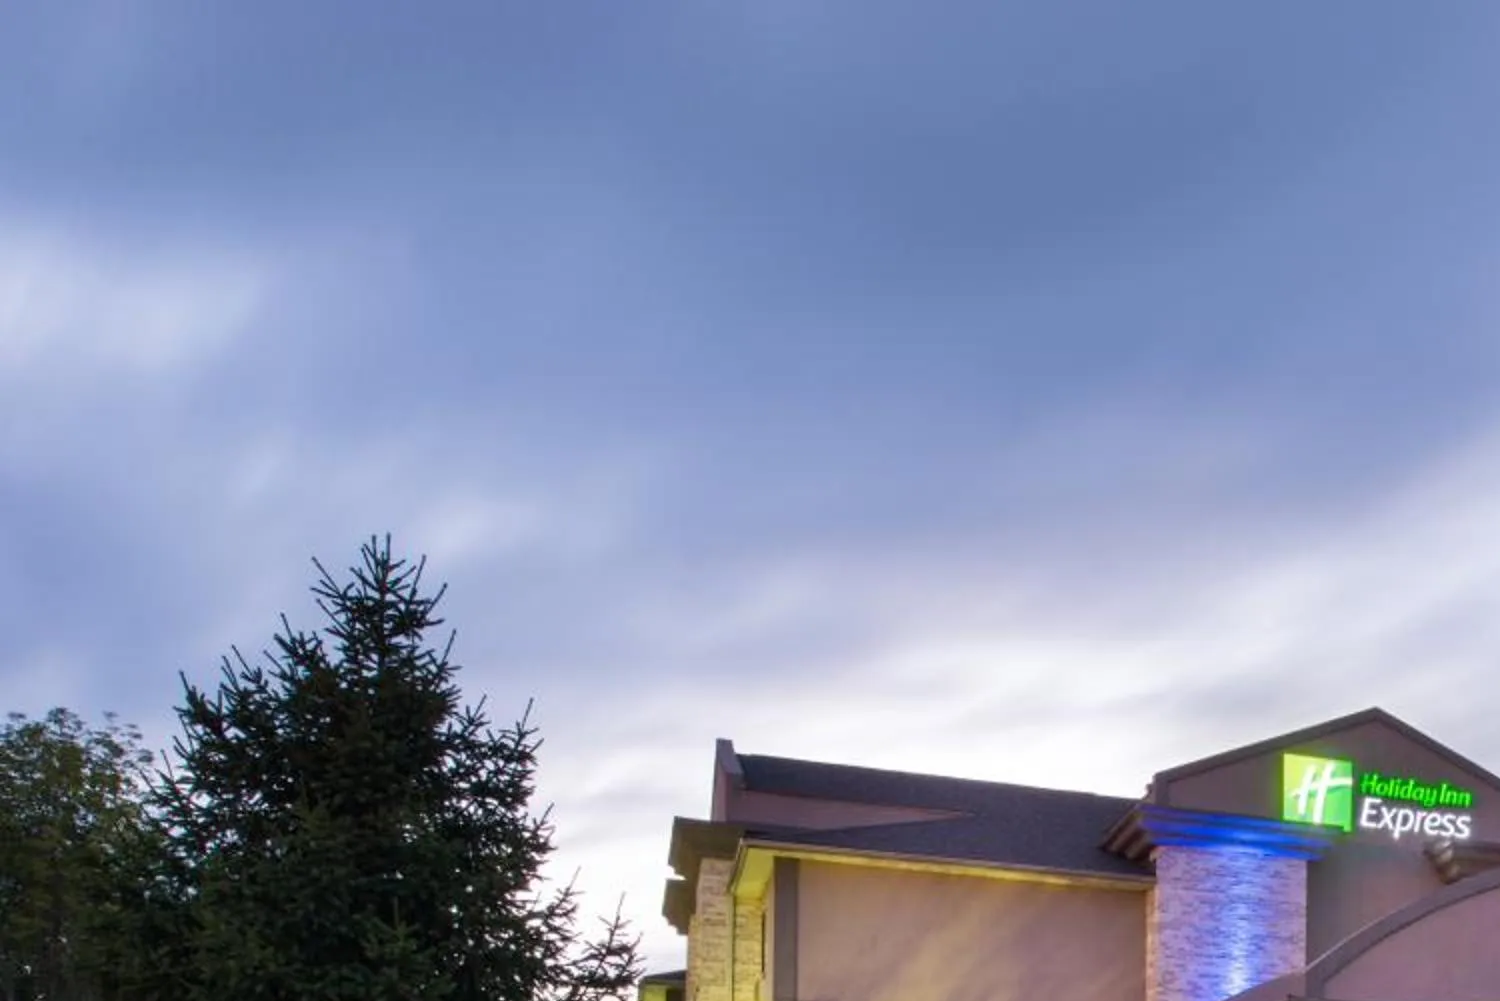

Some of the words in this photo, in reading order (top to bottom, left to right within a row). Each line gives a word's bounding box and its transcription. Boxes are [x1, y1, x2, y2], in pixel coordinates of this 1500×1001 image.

[1361, 773, 1438, 807] Holiday
[1439, 783, 1472, 808] Inn
[1360, 797, 1472, 839] Express
